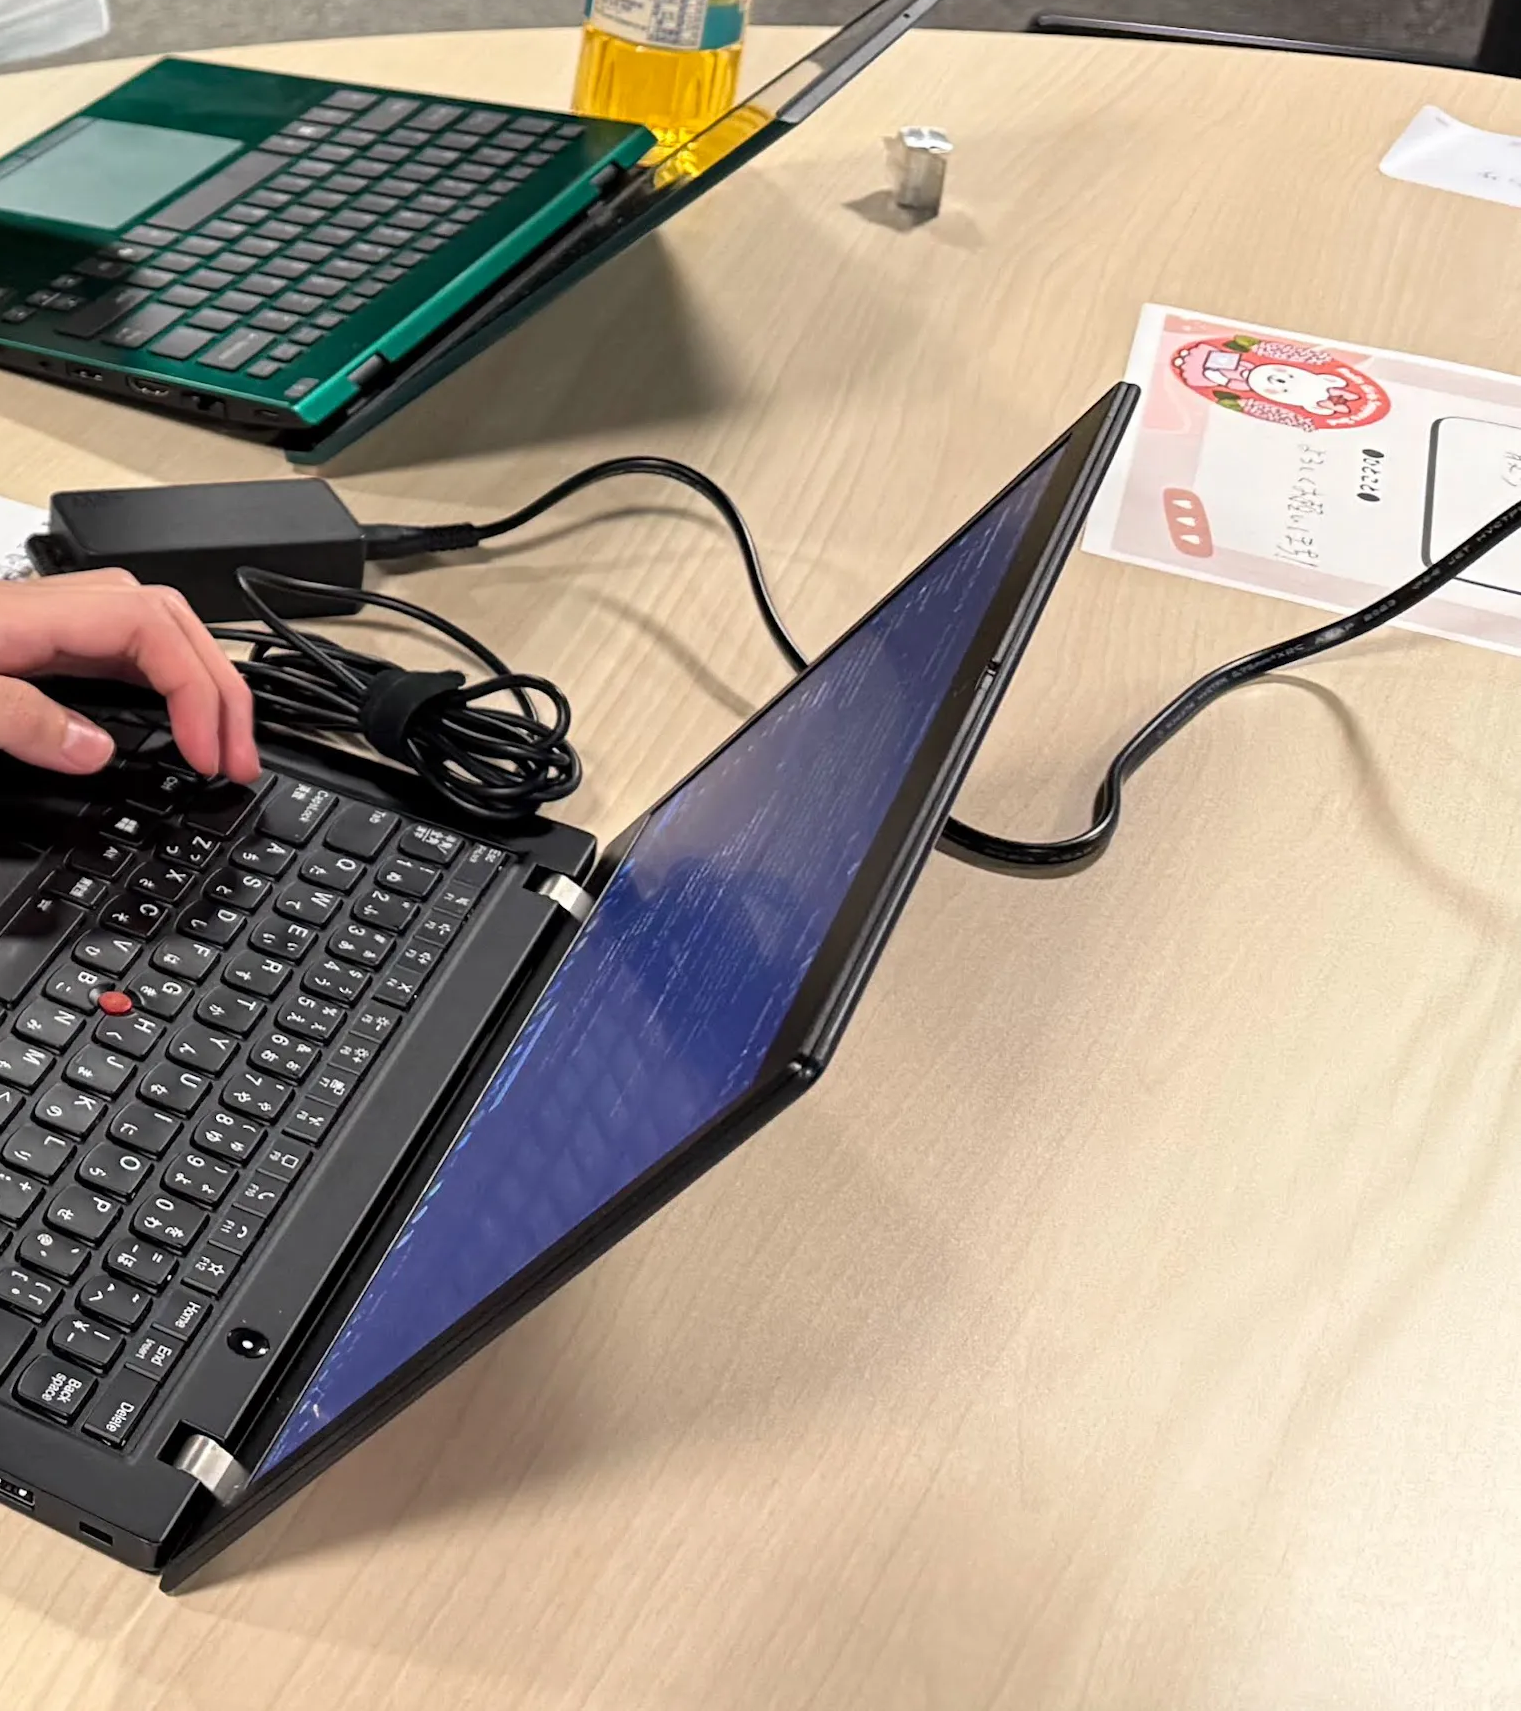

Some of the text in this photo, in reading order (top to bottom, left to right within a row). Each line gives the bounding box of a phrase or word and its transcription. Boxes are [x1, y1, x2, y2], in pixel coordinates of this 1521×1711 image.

[194, 836, 213, 851] Z
[266, 843, 287, 856] A
[335, 858, 357, 871] Q
[396, 859, 414, 868] 1
[165, 868, 188, 884] X
[242, 876, 263, 889] S
[310, 891, 334, 908] W
[371, 890, 391, 903] 2
[139, 903, 160, 917] C
[217, 909, 238, 922] D
[287, 924, 309, 938] E
[347, 925, 367, 937] 3
[113, 939, 134, 952] V
[193, 944, 211, 958] F
[261, 958, 283, 974] R
[323, 960, 341, 972] 4
[77, 971, 98, 986] B
[161, 981, 184, 996] G
[236, 999, 258, 1011] T
[297, 996, 317, 1009] 5
[53, 1010, 77, 1026] N
[133, 1017, 156, 1035] H
[209, 1037, 230, 1051] Y
[271, 1034, 290, 1047] 6
[23, 1048, 47, 1066] M
[106, 1055, 125, 1070] J
[179, 1072, 203, 1089] U
[245, 1073, 263, 1087] 7
[74, 1094, 97, 1110] K
[153, 1112, 174, 1124] I
[215, 1113, 235, 1126] 8
[43, 1135, 66, 1147] L
[119, 1155, 141, 1171] O
[186, 1154, 206, 1168] 9
[92, 1196, 112, 1213] P
[155, 1198, 175, 1212] 0
[195, 1256, 211, 1272] F12
[174, 1301, 202, 1329] Home
[150, 1344, 173, 1367] End
[41, 1372, 68, 1403] space
[55, 1377, 83, 1404] Back
[105, 1401, 135, 1433] Delete
